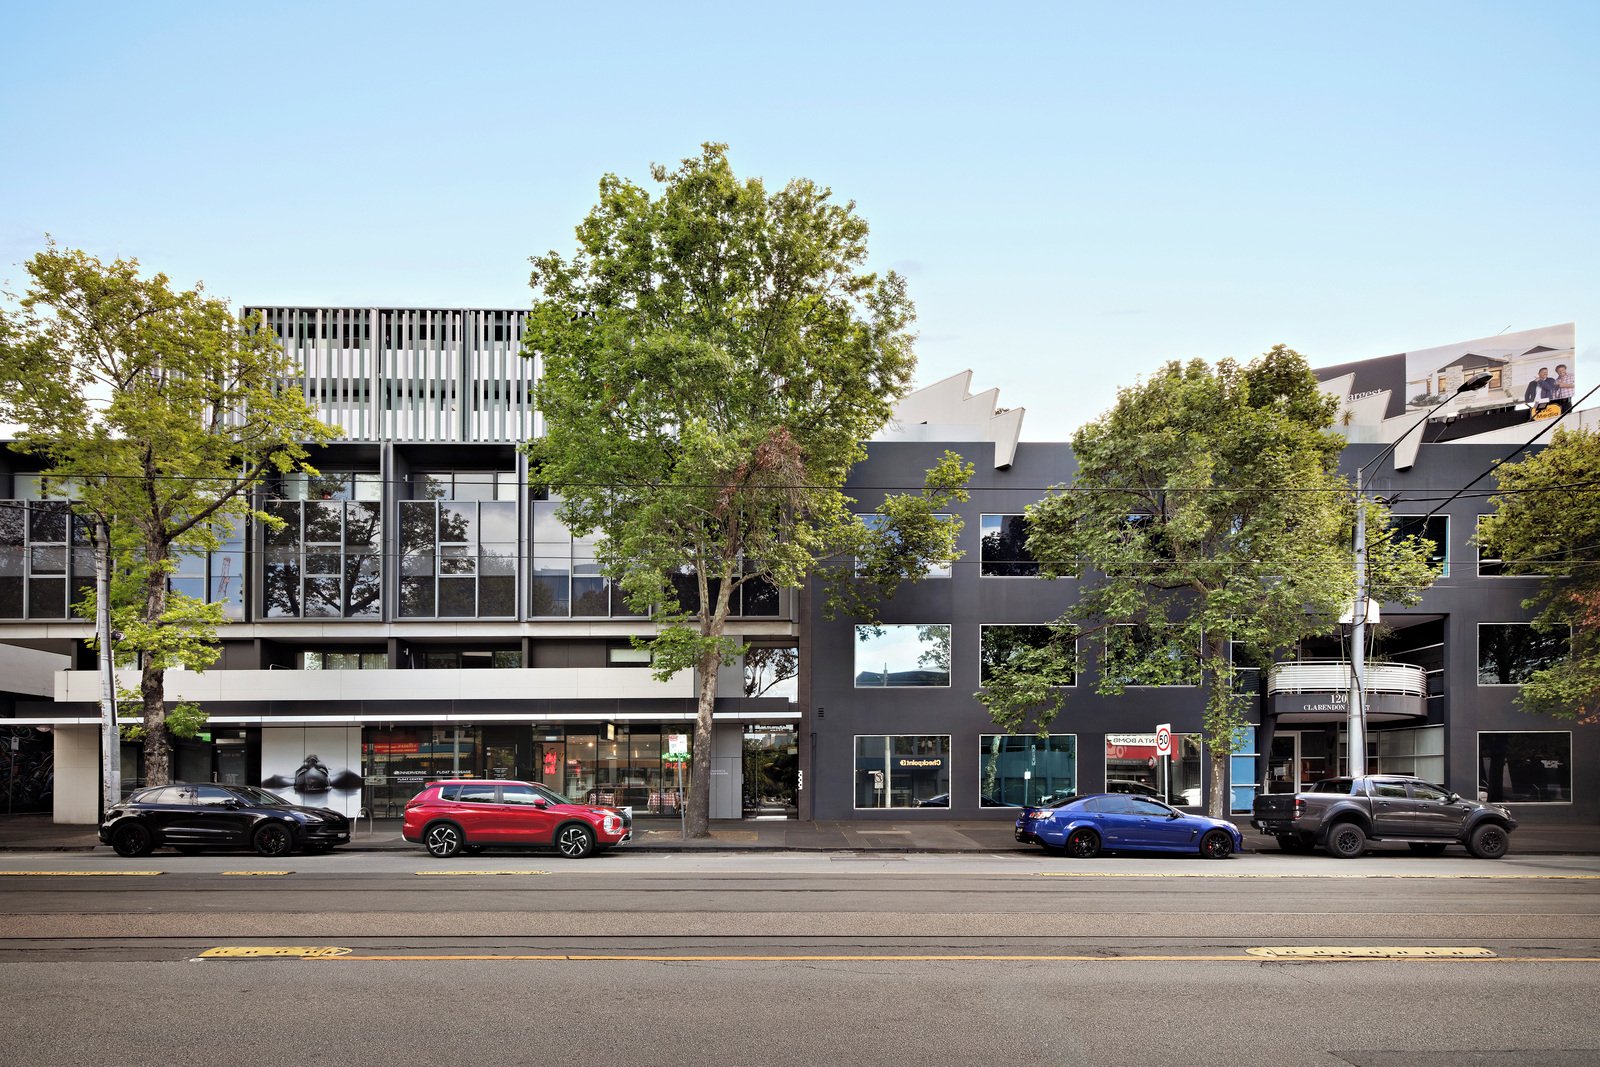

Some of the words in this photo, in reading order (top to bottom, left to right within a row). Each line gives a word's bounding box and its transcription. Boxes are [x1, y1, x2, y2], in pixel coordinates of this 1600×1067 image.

[1347, 388, 1382, 401] argest
[1331, 694, 1347, 704] 120
[1303, 703, 1346, 711] CLARENDON
[1159, 734, 1169, 746] 50
